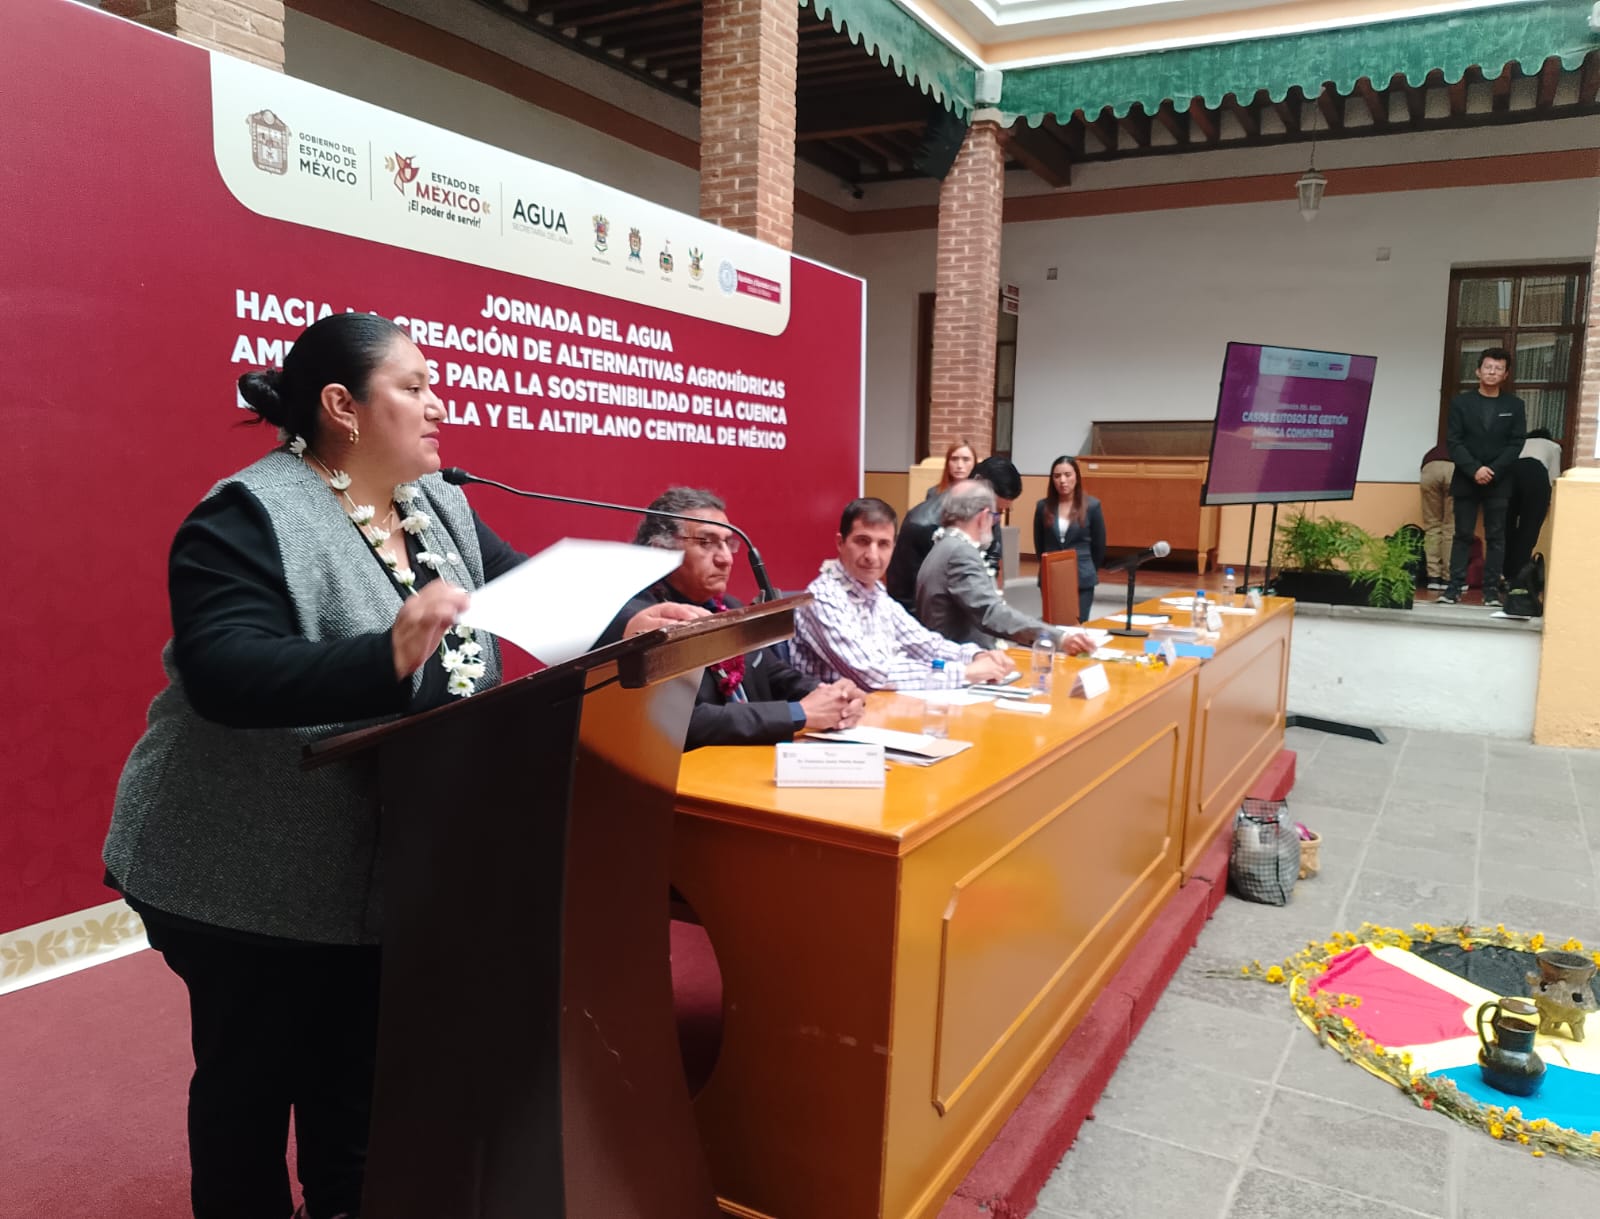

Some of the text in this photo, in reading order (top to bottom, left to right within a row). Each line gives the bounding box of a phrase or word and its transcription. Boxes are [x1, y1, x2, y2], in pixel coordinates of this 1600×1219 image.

[299, 132, 356, 155] GOBIERNO DEL
[300, 144, 357, 169] ESTADO DE
[300, 158, 357, 186] MÉXICO
[431, 172, 480, 194] ESTADO DE
[415, 180, 480, 213] MÉXICO
[421, 203, 445, 219] poder
[446, 209, 456, 221] de
[457, 213, 481, 228] servir!
[512, 198, 568, 235] AGUA
[481, 294, 673, 352] JORNADA DEL AGUA
[523, 334, 551, 364] DE
[556, 343, 684, 384] ALTERNATIVAS
[687, 366, 786, 399] AGROHÍDRICAS
[446, 361, 510, 393] PARA
[514, 371, 543, 397] LA
[548, 376, 689, 414] SOSTENIBILIDAD
[692, 395, 712, 417] DE
[715, 398, 734, 418] LA
[735, 401, 787, 426] CUENCA
[486, 403, 503, 427] Y
[507, 406, 533, 430] EL
[539, 409, 642, 439] ALTIPLANO
[645, 422, 715, 445] CENTRAL
[717, 426, 736, 447] DE
[738, 425, 787, 451] MÉXICO
[1242, 411, 1269, 423] CASOS
[1308, 414, 1318, 424] DE
[1286, 427, 1334, 438] COMUNITARIA
